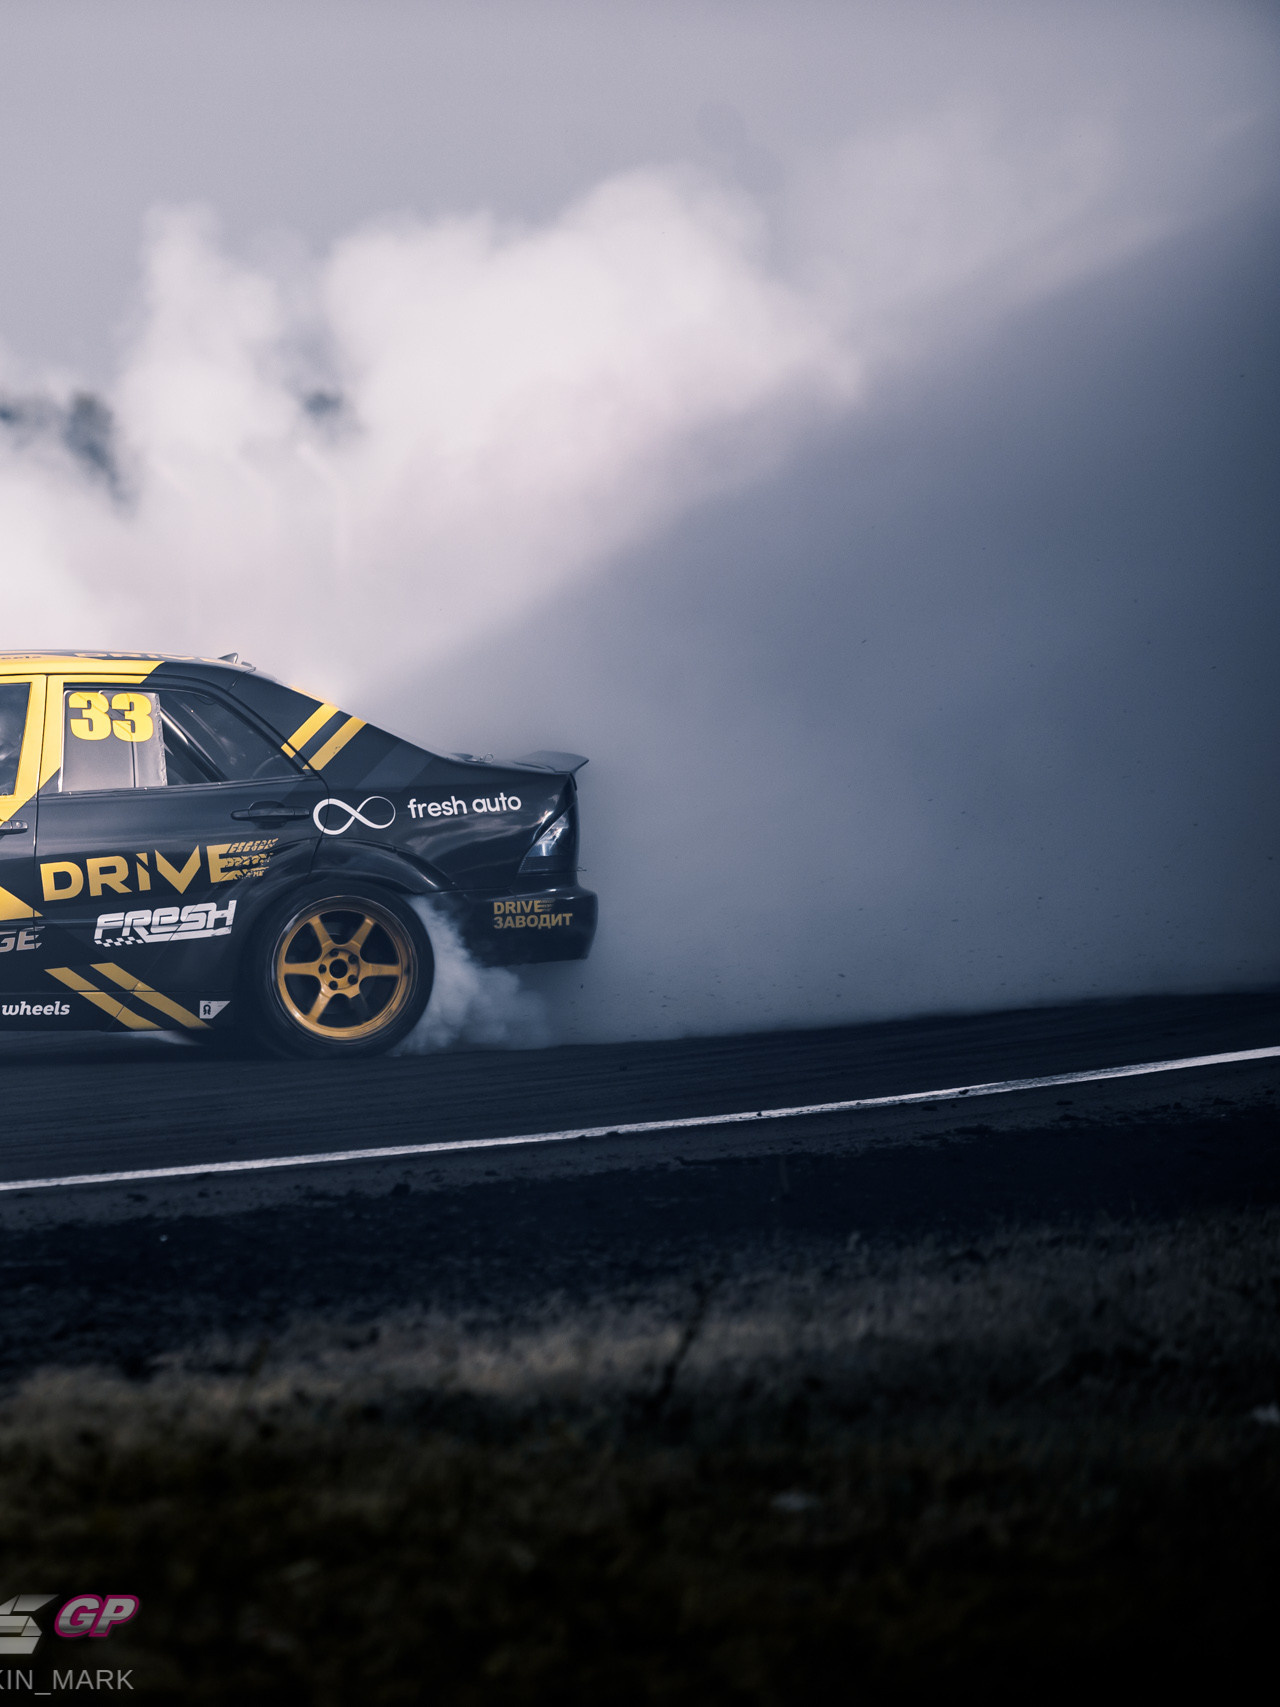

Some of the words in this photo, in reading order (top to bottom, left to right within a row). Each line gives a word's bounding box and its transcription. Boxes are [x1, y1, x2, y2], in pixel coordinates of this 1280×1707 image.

[69, 691, 154, 742] 33
[407, 796, 467, 819] fresh
[472, 792, 522, 813] auto
[39, 838, 279, 902] DRIVE
[493, 900, 554, 915] DRIVE
[93, 900, 237, 944] FRESH
[493, 913, 573, 930] ЗАВОДИТ
[2, 1001, 71, 1016] wheels
